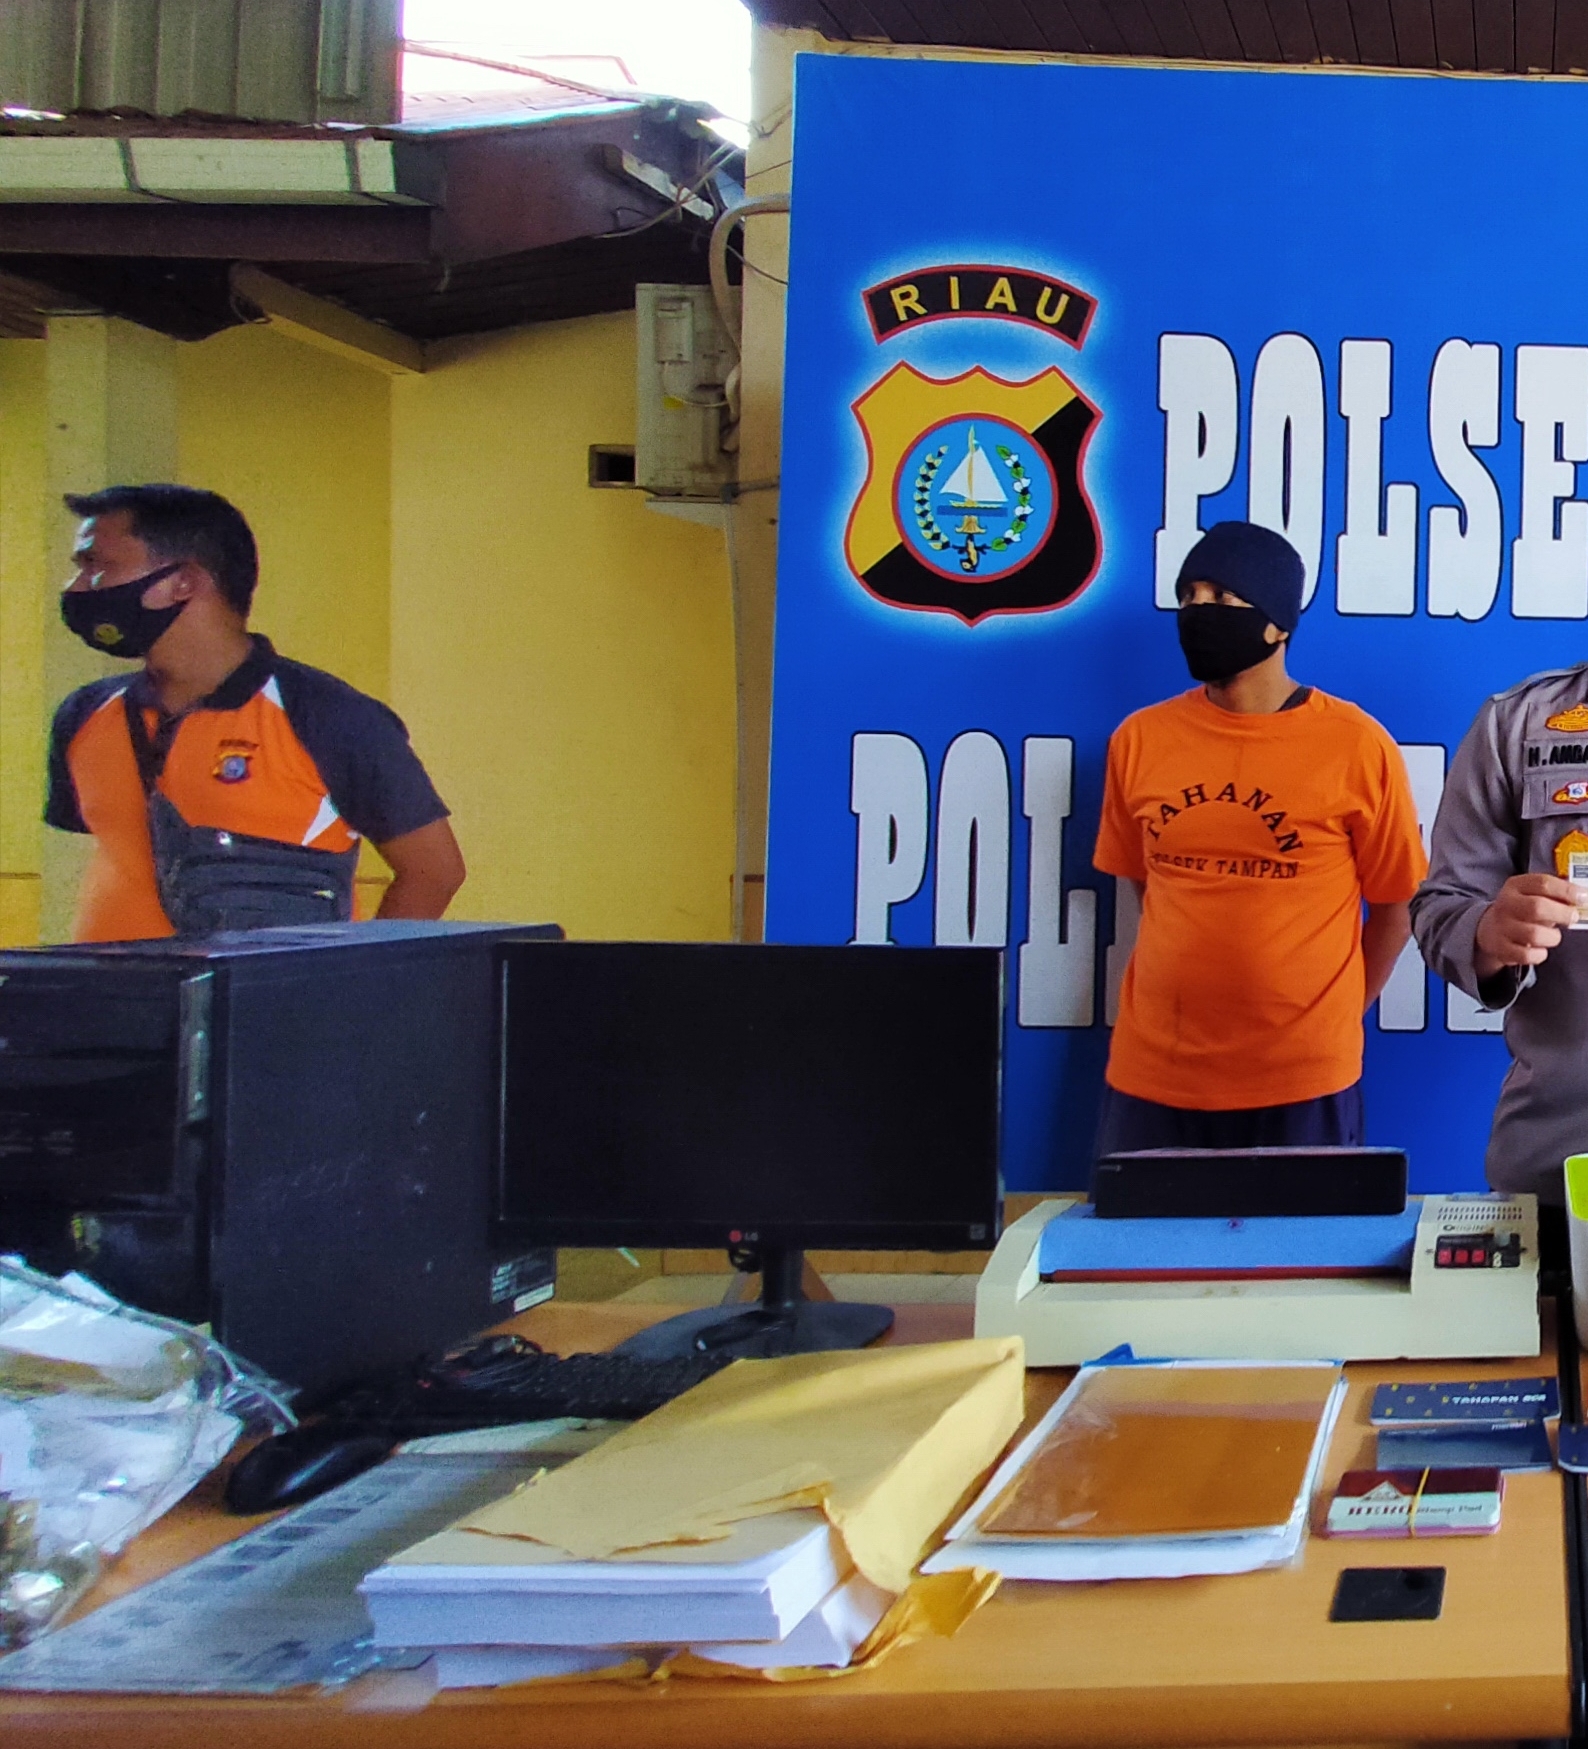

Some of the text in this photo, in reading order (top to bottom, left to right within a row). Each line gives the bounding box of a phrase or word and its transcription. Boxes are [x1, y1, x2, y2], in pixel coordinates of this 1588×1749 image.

[888, 274, 1070, 327] RIAU
[1145, 782, 1304, 853] TAHANAN
[1215, 858, 1300, 879] TAMPAN
[1451, 1395, 1519, 1405] TAHAPAN
